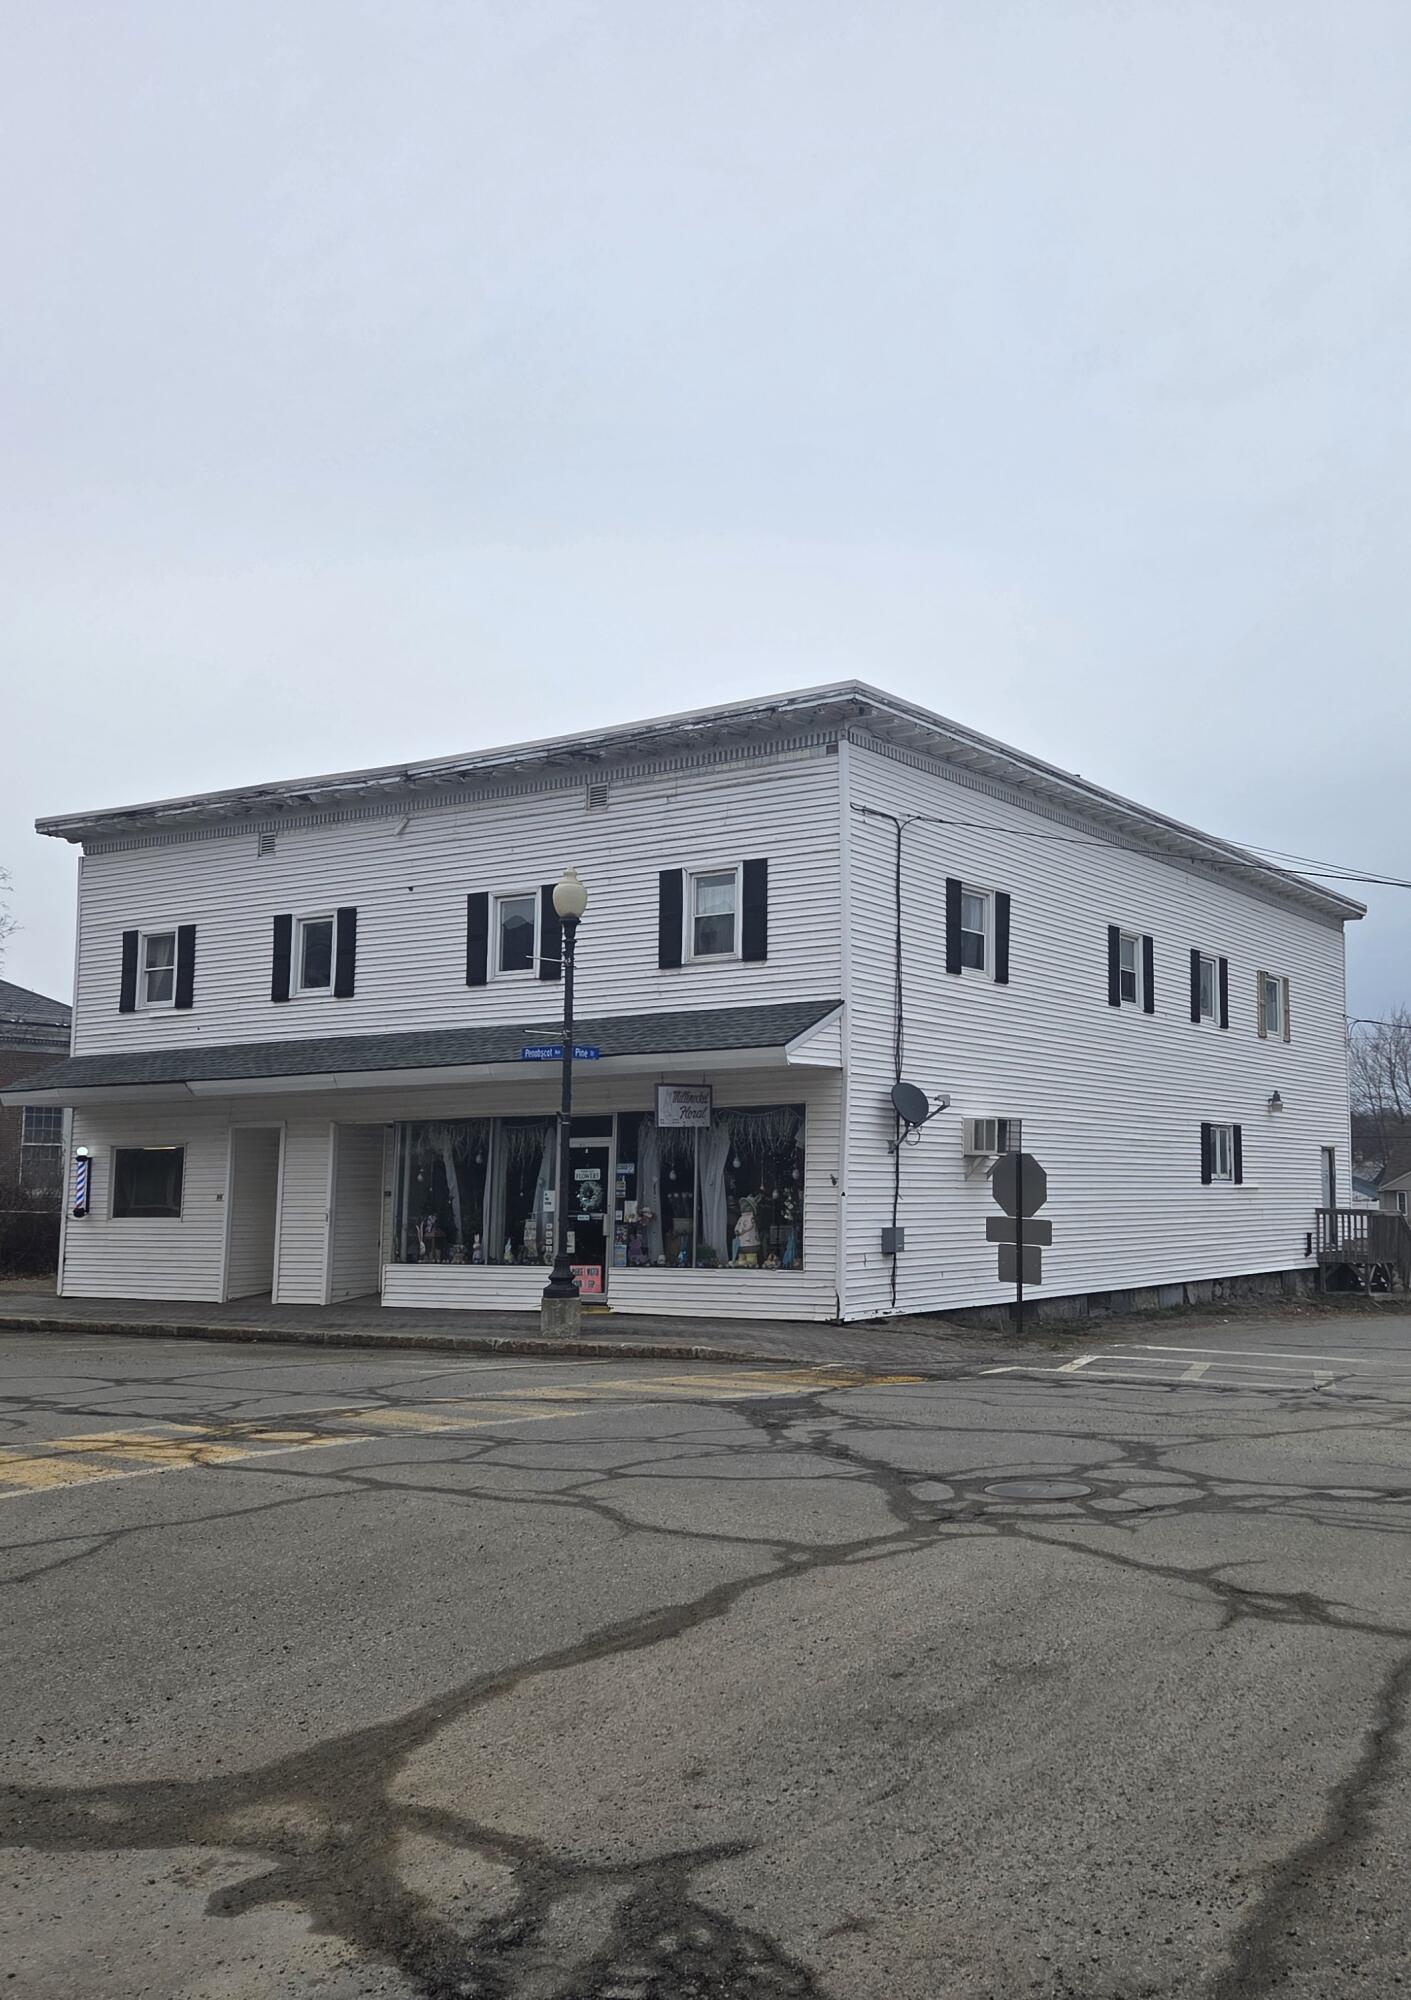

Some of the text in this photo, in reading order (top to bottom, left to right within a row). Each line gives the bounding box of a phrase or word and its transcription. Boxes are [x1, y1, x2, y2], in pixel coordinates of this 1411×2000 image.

[524, 1048, 553, 1058] Penobscot
[574, 1047, 589, 1058] Pine
[680, 1105, 708, 1119] Floral
